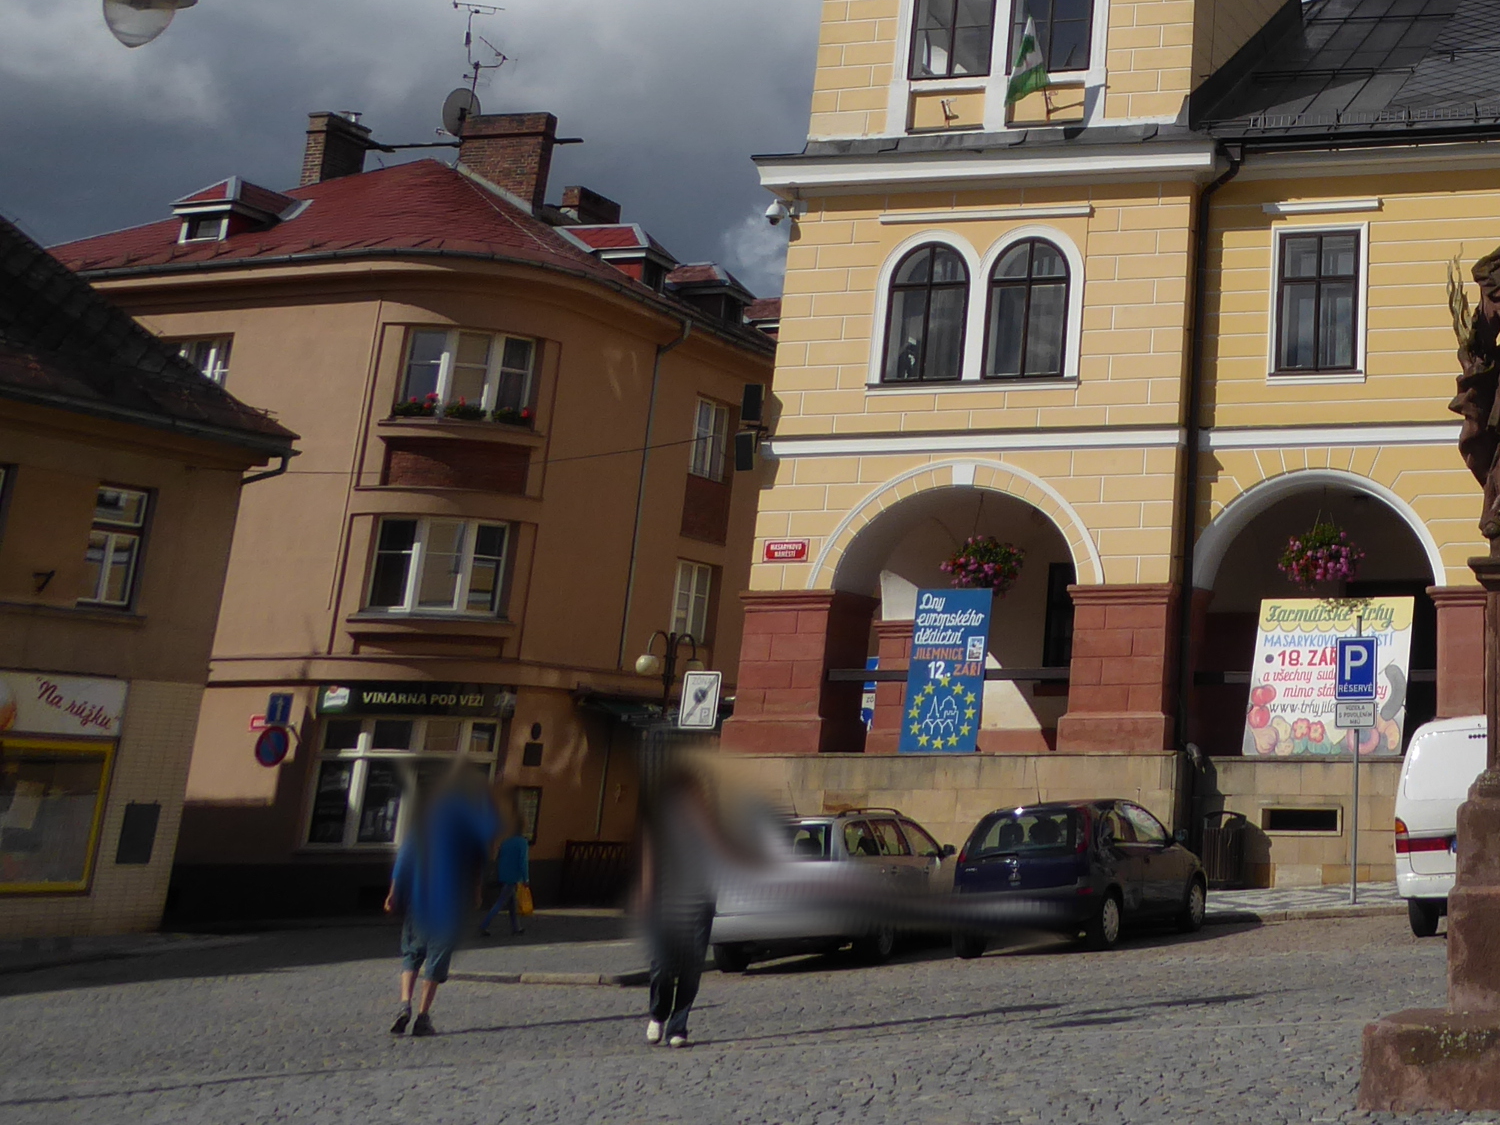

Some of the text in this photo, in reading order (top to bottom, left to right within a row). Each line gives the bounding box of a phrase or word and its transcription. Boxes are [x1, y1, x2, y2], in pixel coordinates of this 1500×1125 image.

[919, 593, 946, 612] Dny
[916, 609, 985, 629] evropského
[1362, 603, 1394, 628] trhy
[914, 627, 965, 644] dědictví
[1264, 635, 1337, 647] MASARYKOVO
[913, 647, 964, 660] JILEMNICE
[1278, 650, 1303, 666] 18.
[928, 661, 982, 679] 12. ZÁŘÍ
[1344, 645, 1368, 680] P
[1263, 671, 1271, 682] a
[1273, 668, 1312, 683] všechny
[1283, 685, 1314, 697] mimo
[1338, 682, 1374, 693] RÉSERVÉ
[429, 693, 456, 705] POD
